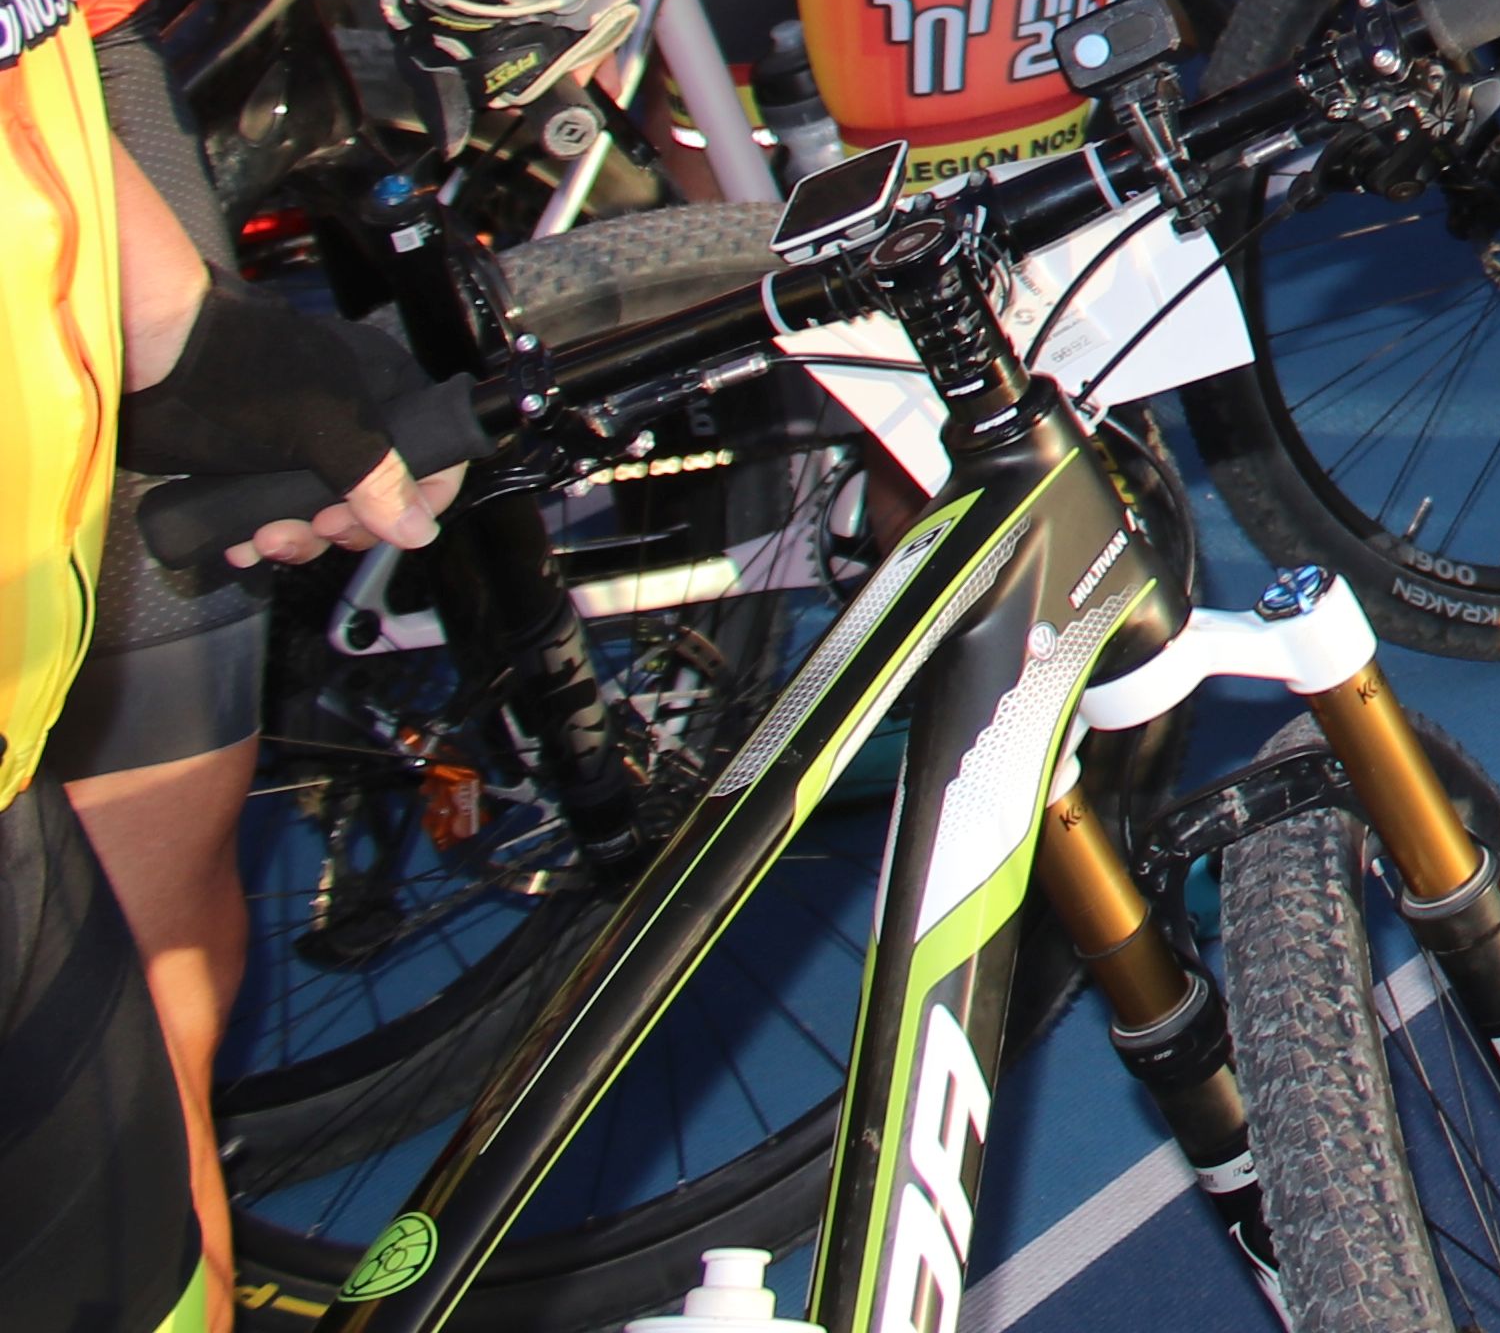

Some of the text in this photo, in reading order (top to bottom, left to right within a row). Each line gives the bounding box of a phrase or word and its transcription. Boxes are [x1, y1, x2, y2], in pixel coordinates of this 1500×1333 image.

[1029, 125, 1080, 163] NOS
[1068, 528, 1130, 611] MULTIVAN
[1391, 576, 1500, 627] KRAKEN
